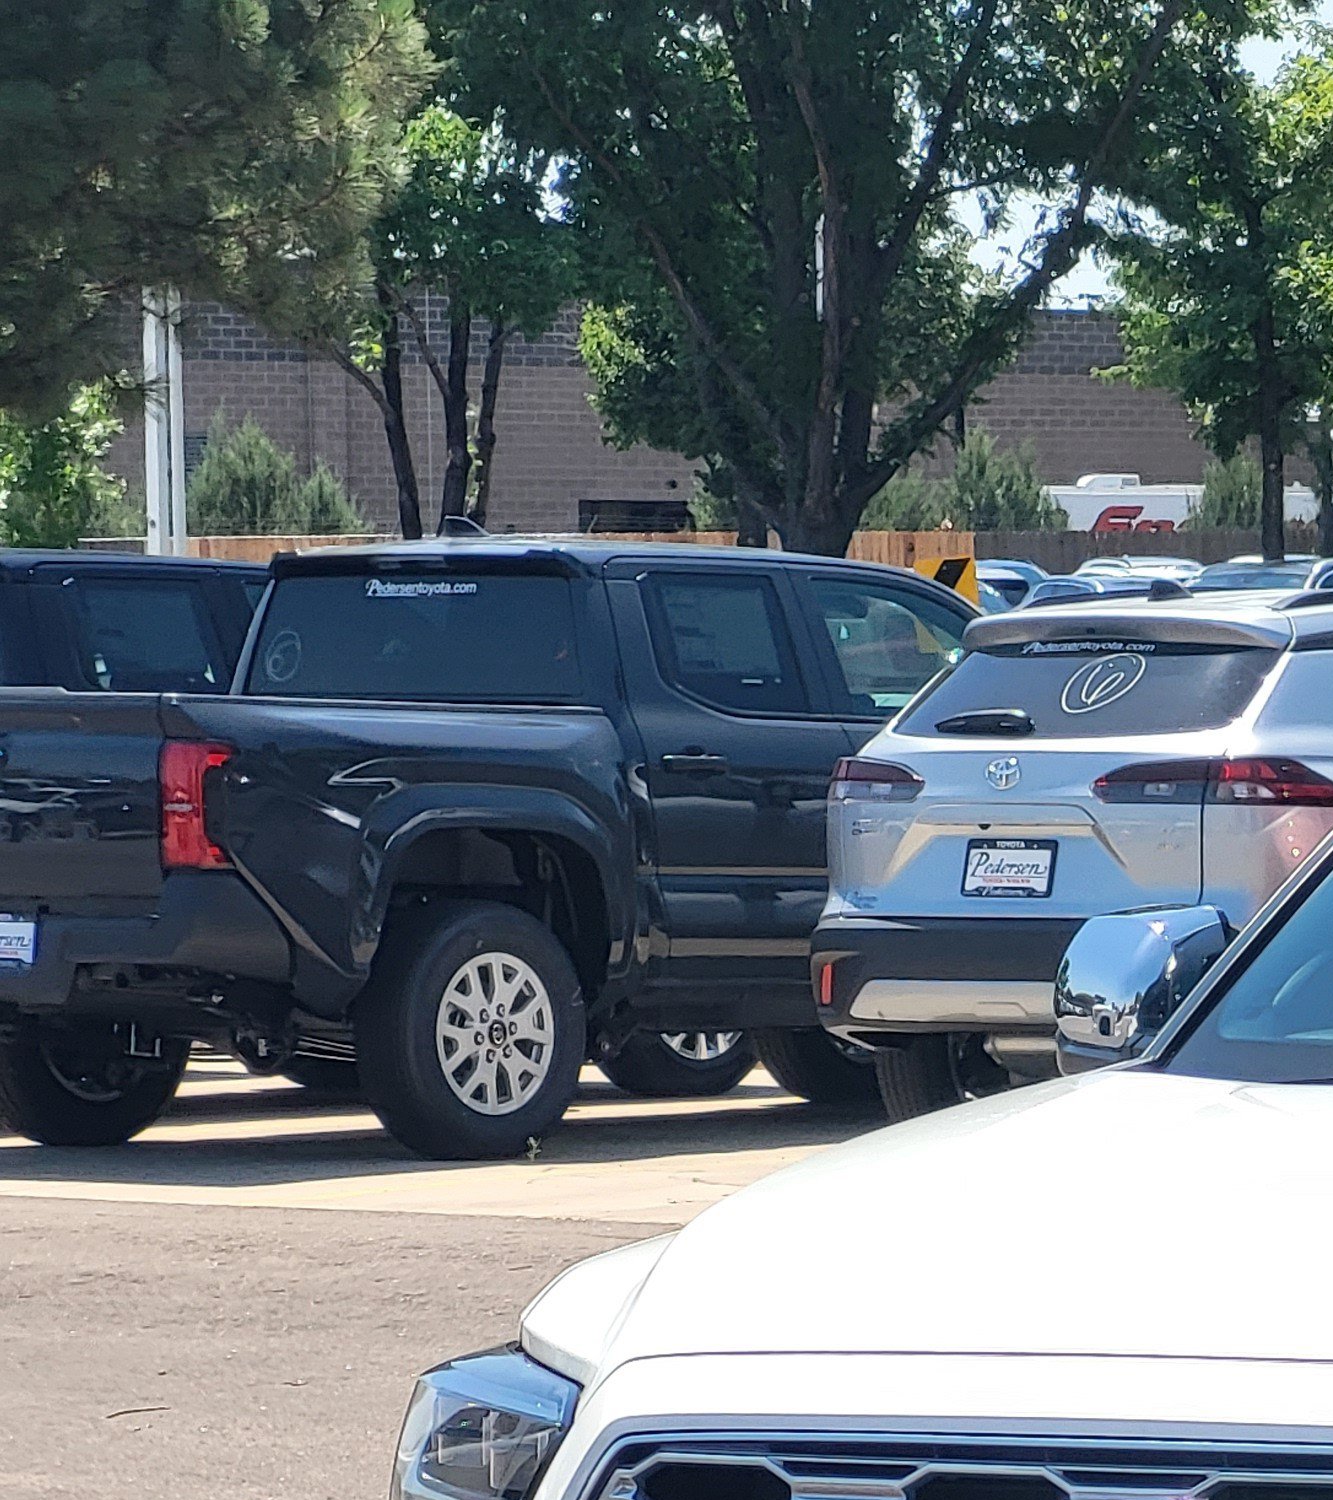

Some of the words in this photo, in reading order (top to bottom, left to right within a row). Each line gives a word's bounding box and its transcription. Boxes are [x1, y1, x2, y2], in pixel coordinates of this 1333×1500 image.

[365, 579, 477, 597] Pedersentoyota.com
[996, 841, 1026, 849] TOYOTA
[970, 851, 1048, 877] Pedersen
